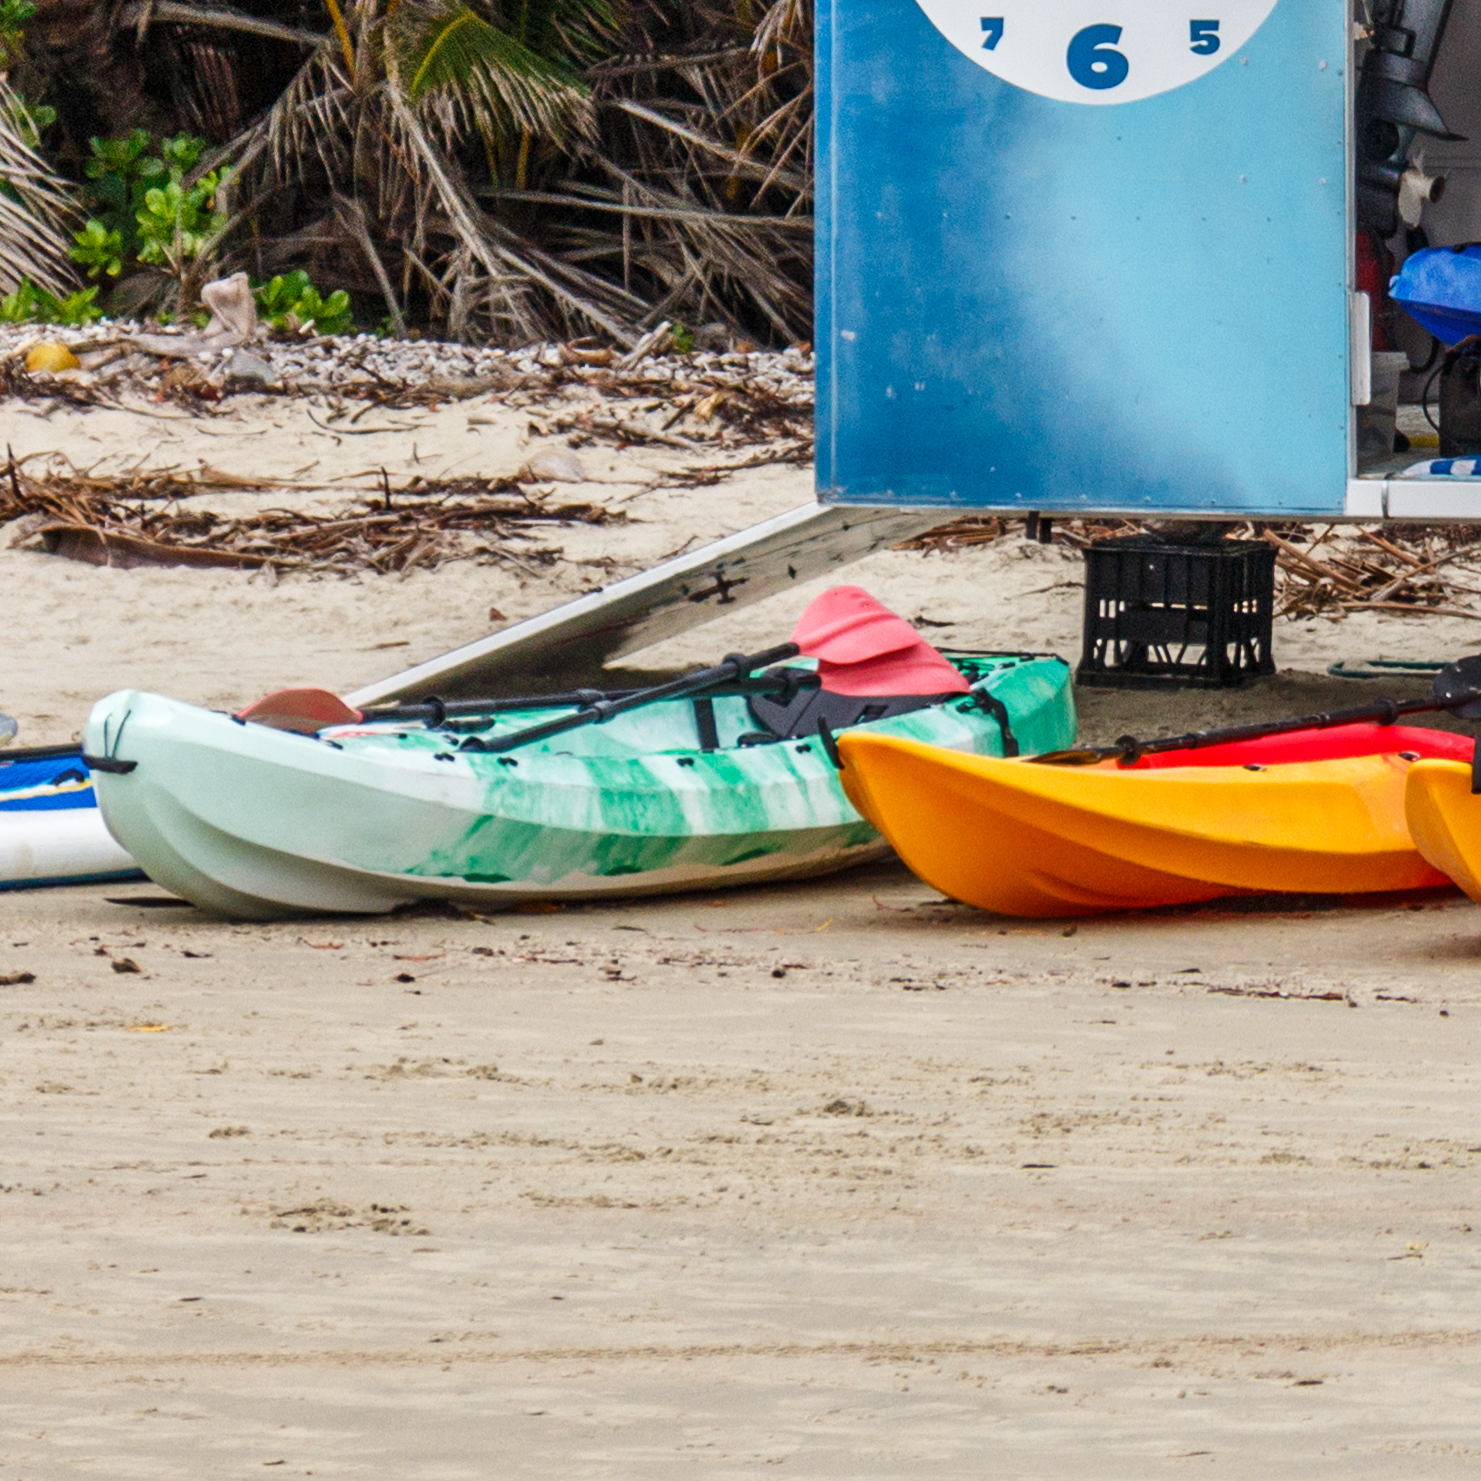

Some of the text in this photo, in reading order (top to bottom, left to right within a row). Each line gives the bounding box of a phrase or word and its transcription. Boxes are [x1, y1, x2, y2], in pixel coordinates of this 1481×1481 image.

[980, 16, 1005, 51] 7
[1189, 19, 1221, 56] 5
[1066, 23, 1130, 90] 6
